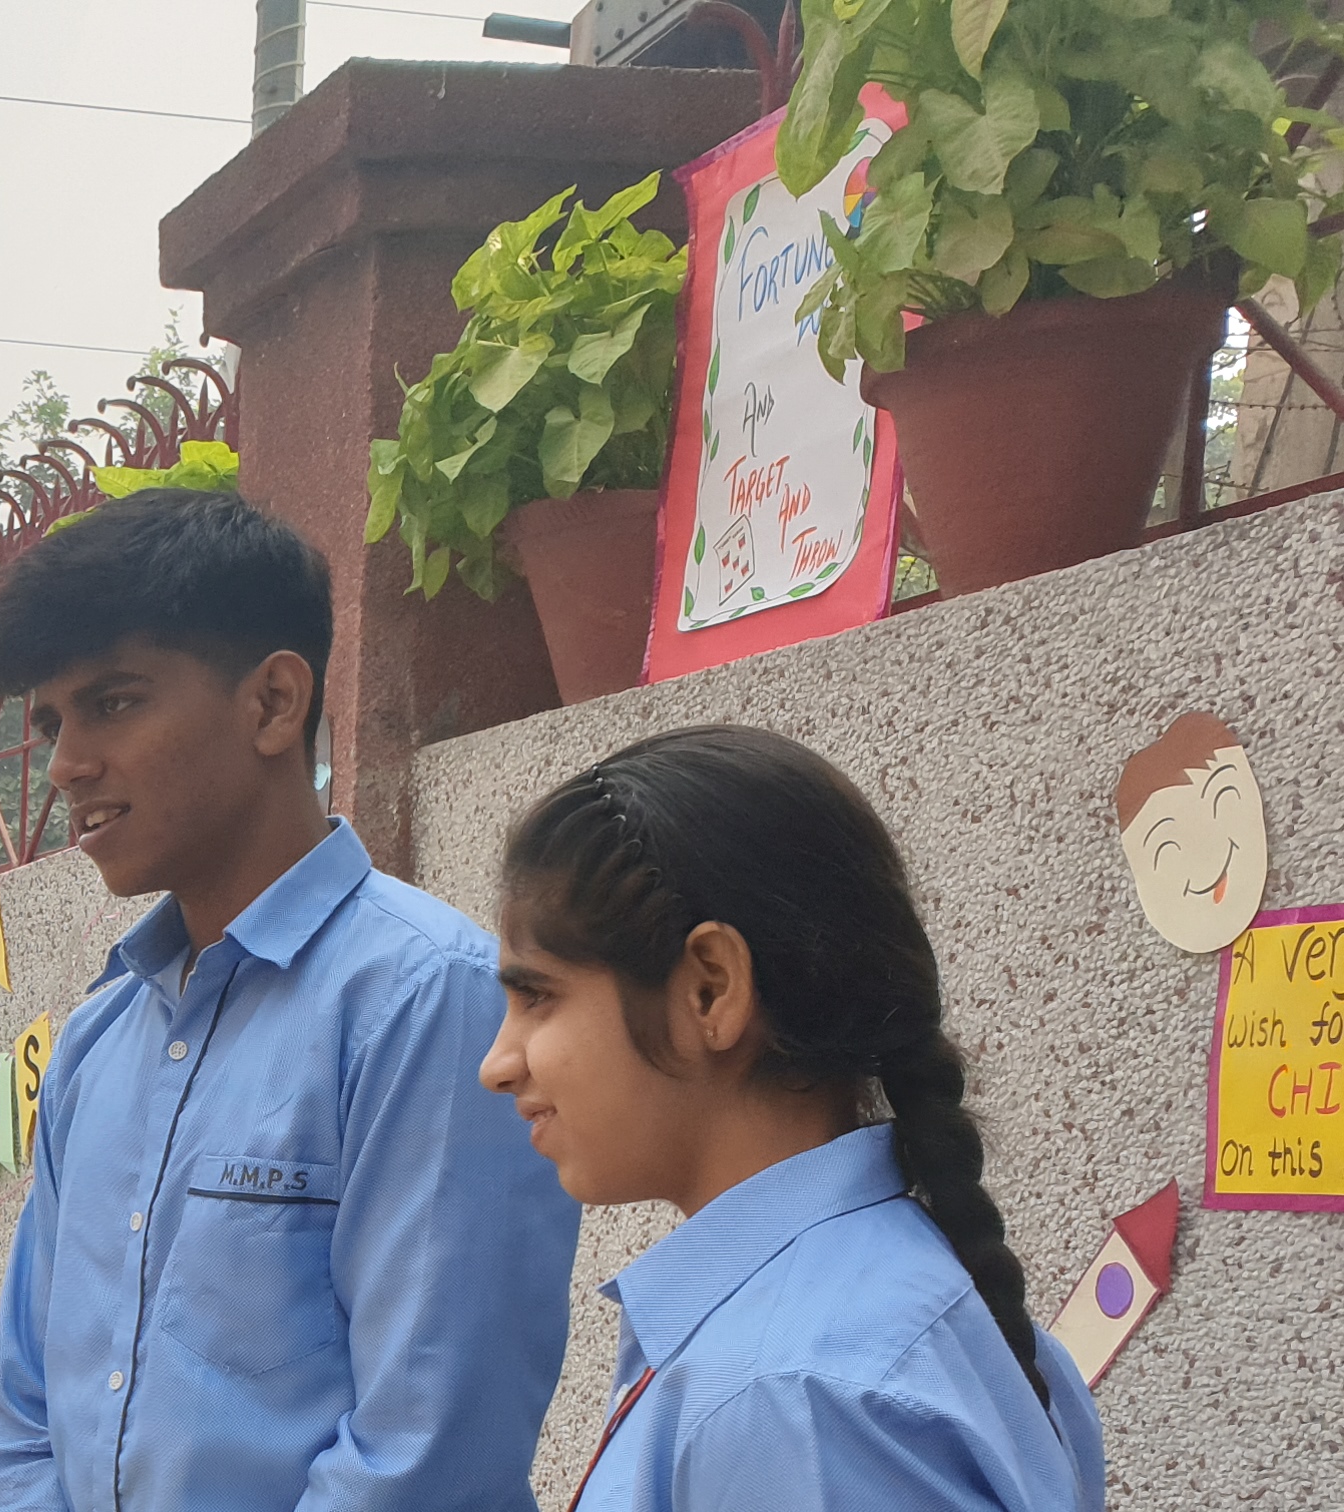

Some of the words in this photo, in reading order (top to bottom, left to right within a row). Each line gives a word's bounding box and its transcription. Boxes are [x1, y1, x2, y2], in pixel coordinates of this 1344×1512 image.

[743, 382, 775, 457] AND
[723, 455, 790, 517] TARGET
[778, 482, 811, 553] AND
[789, 526, 843, 581] THROW
[1233, 931, 1255, 985] A
[1281, 925, 1344, 1000] Ver
[1268, 1136, 1323, 1178] this
